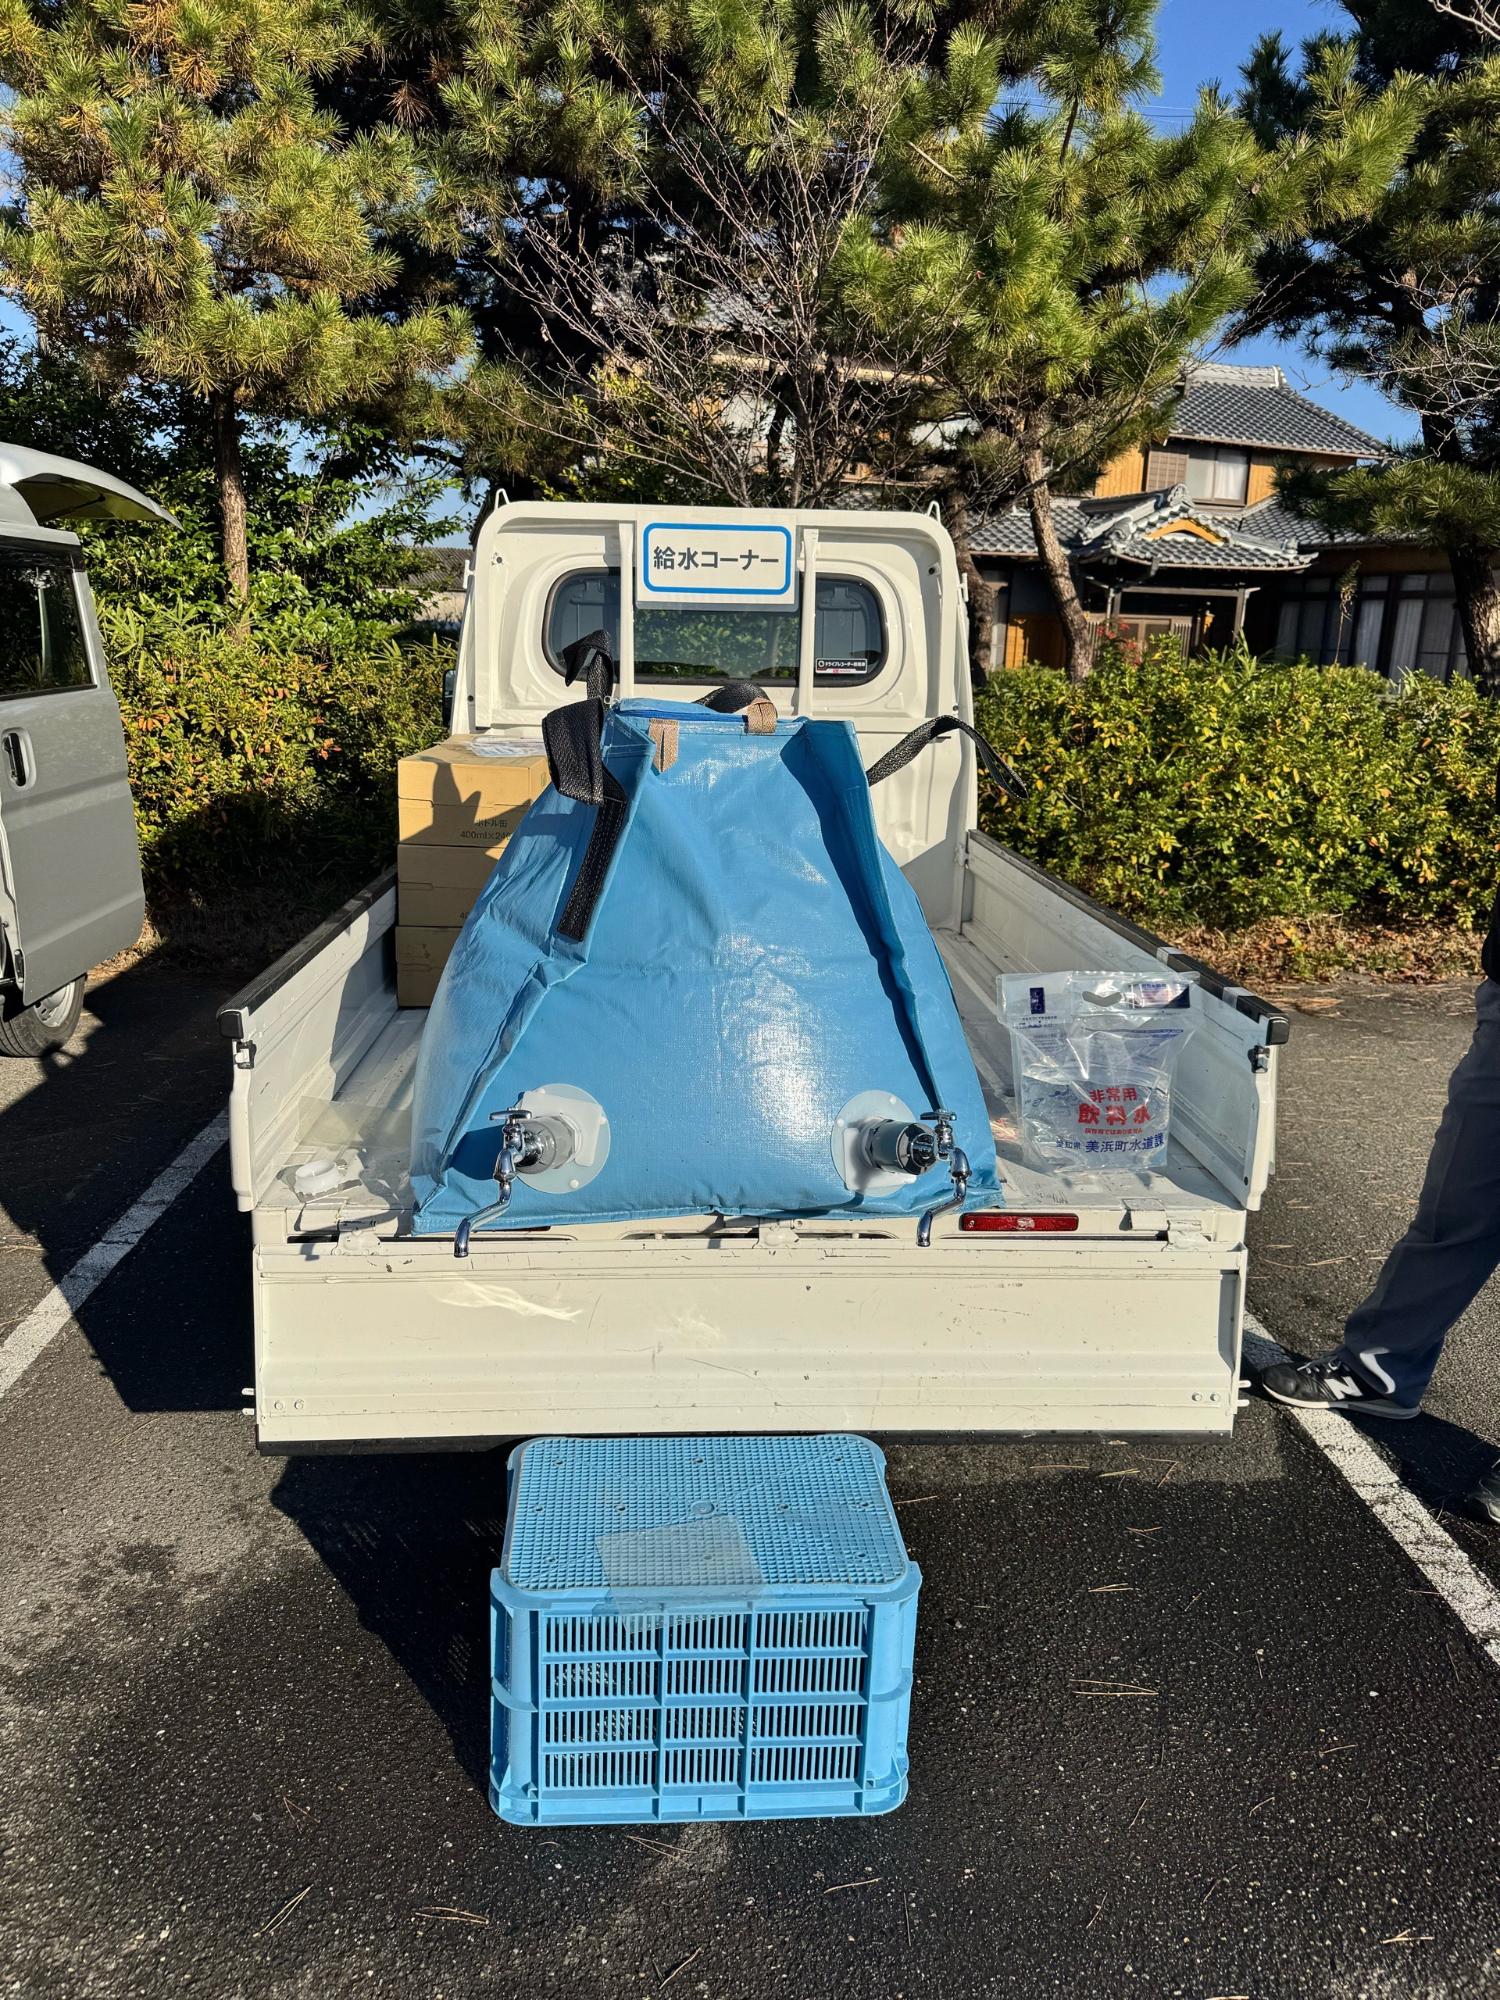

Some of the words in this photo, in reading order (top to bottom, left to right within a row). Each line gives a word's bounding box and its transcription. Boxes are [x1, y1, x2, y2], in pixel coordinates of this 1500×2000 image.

[653, 546, 779, 570] 給水コーナー
[1089, 1087, 1138, 1103] 非常用
[1078, 1103, 1151, 1126] 飲料水
[1085, 1132, 1165, 1153] 美浜町水道課
[1324, 1376, 1362, 1400] N
